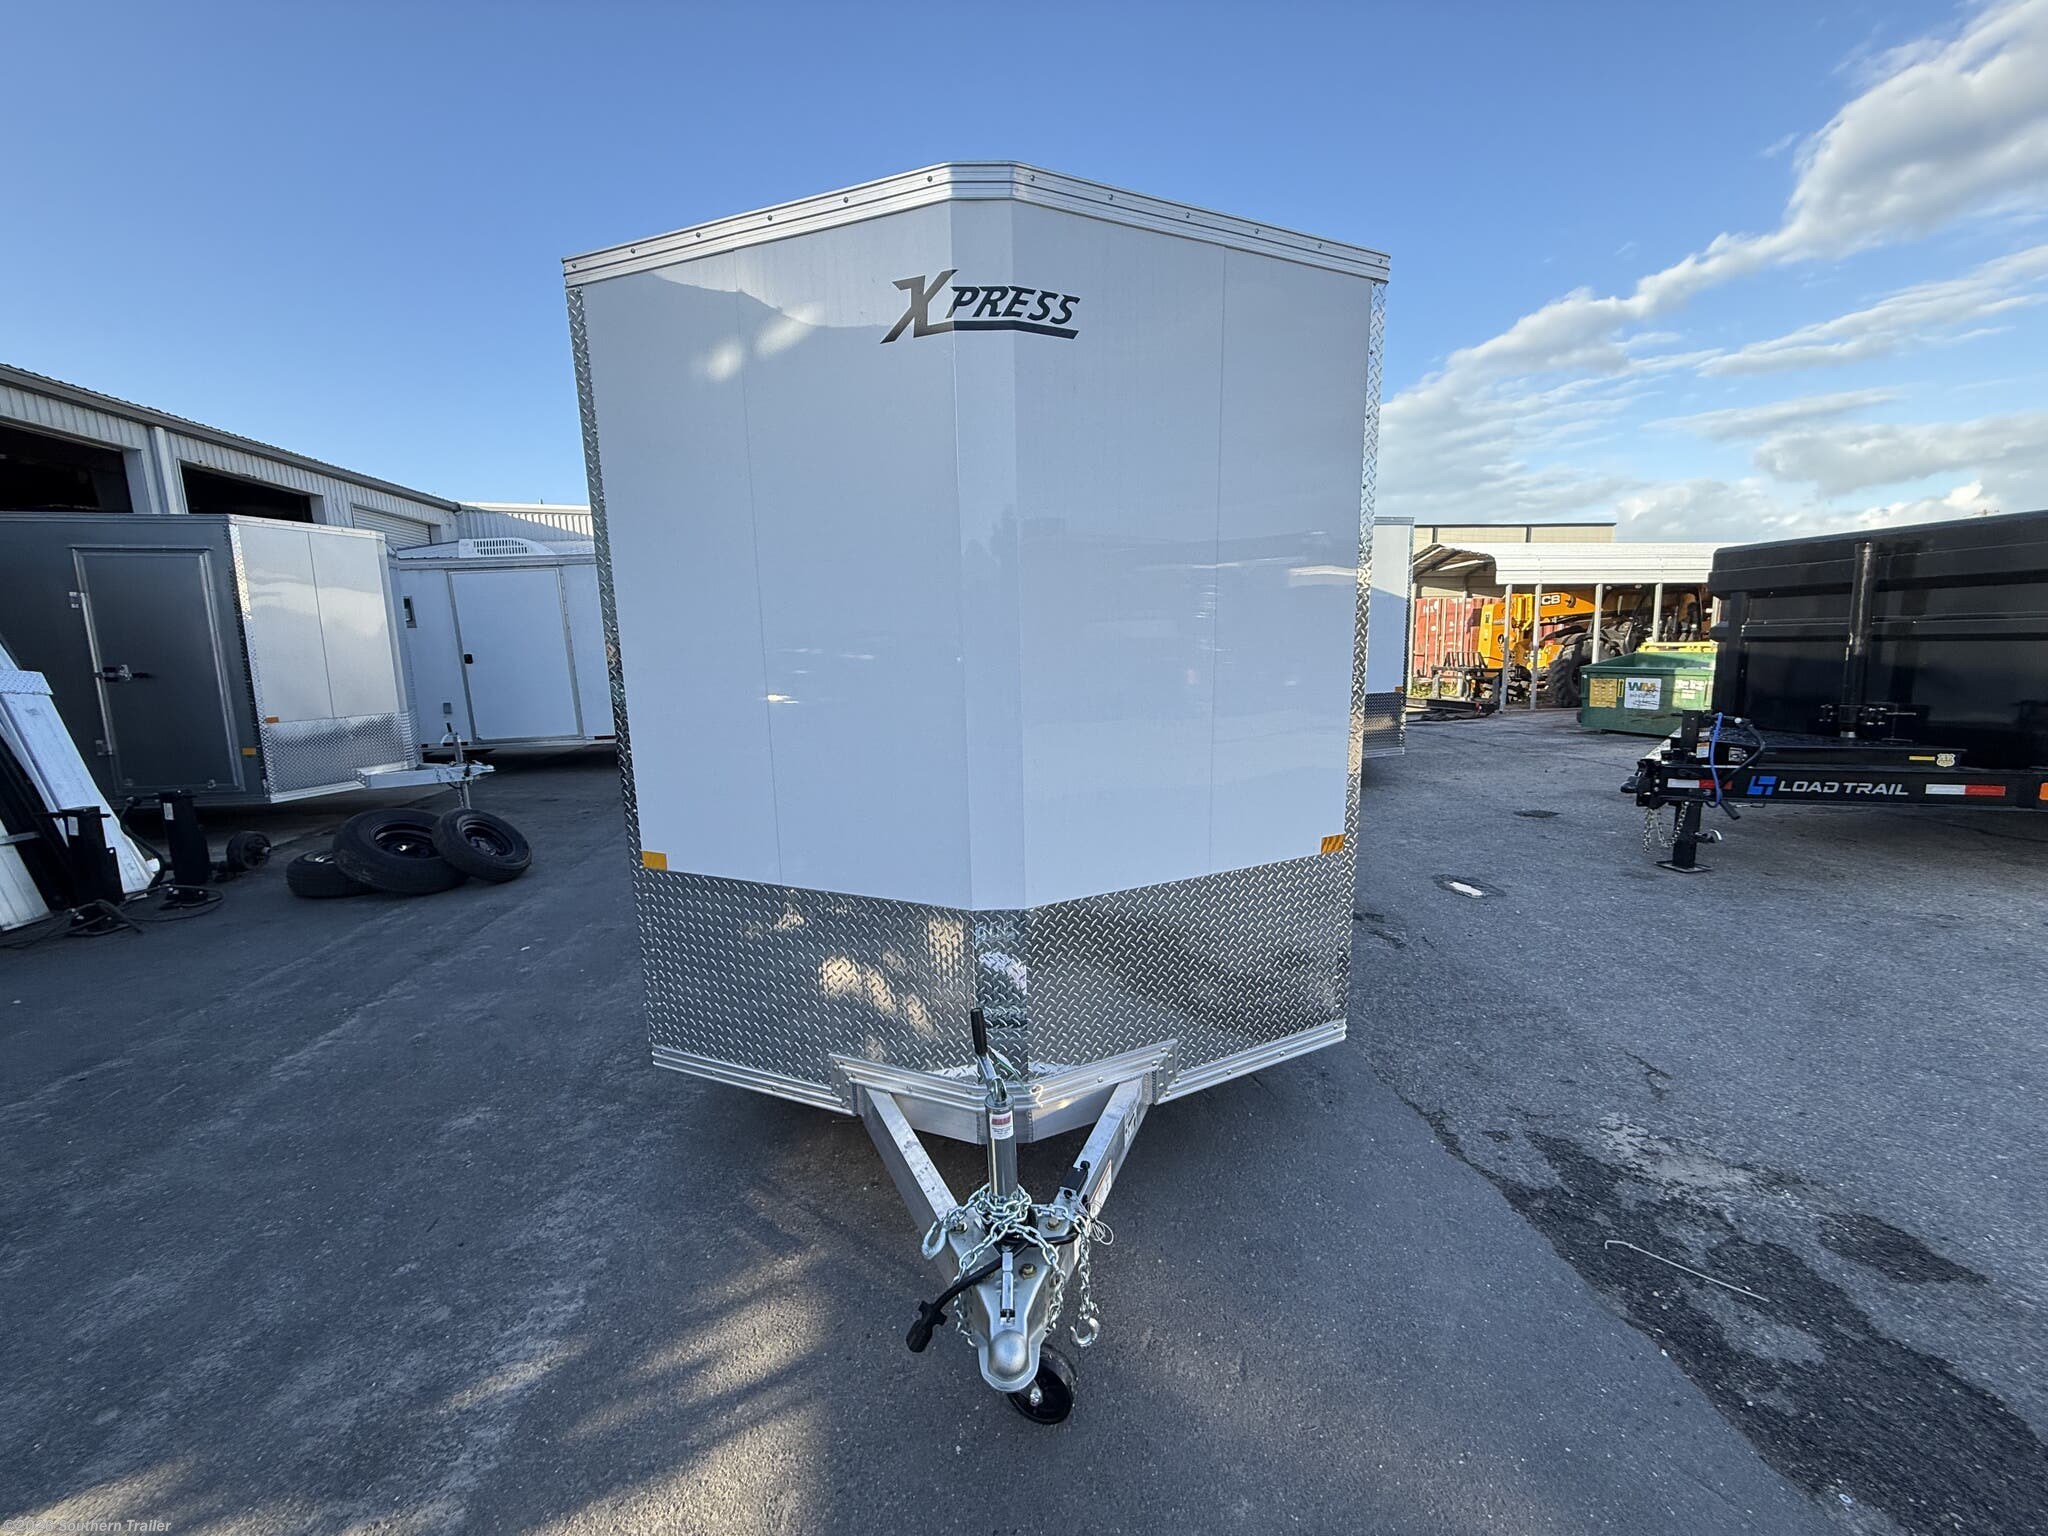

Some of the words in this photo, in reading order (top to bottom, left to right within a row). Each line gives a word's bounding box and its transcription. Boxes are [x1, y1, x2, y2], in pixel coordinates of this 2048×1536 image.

[880, 269, 1081, 344] XPRESS
[1541, 594, 1561, 605] CB
[1778, 780, 1840, 793] LOAD
[1843, 782, 1909, 796] TRAIL
